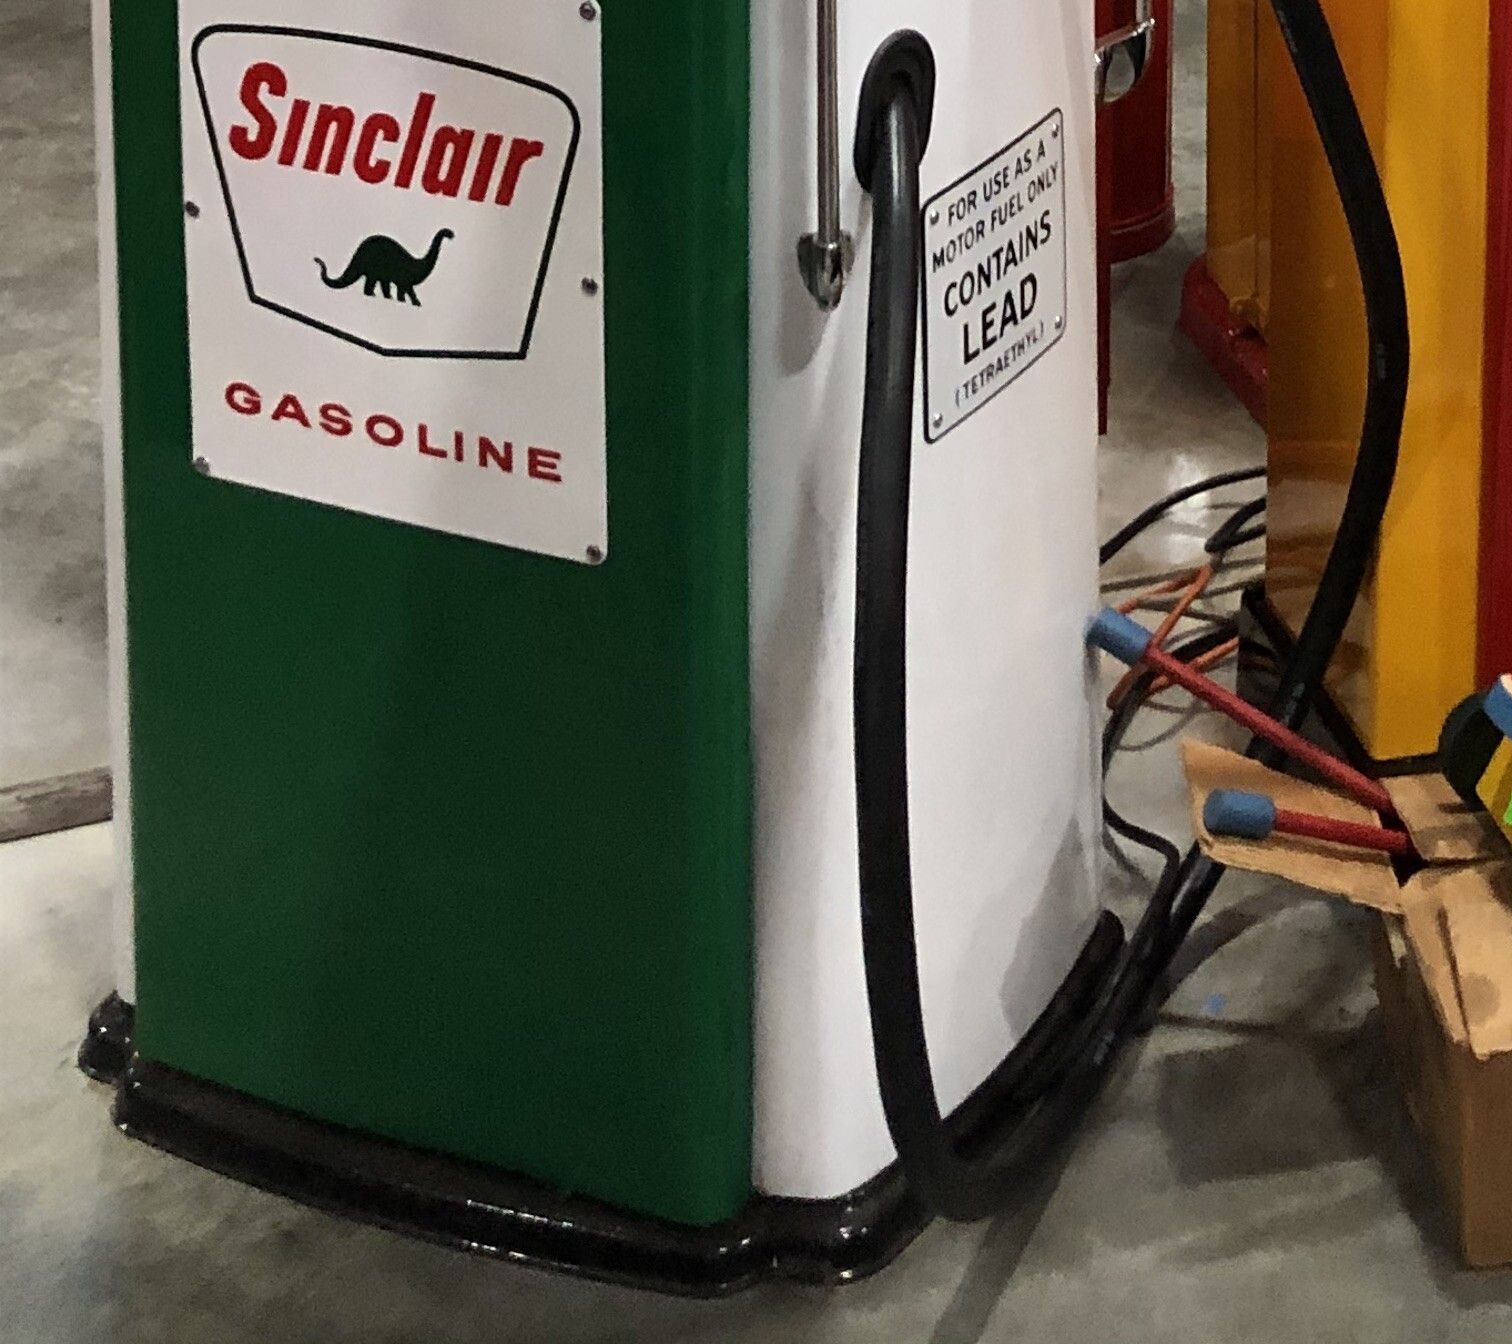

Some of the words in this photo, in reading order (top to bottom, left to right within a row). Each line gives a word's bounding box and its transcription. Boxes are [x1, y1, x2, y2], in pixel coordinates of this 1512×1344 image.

[228, 58, 546, 208] Sinclair
[947, 188, 978, 228] FOR
[982, 167, 1011, 204] USE
[1014, 152, 1033, 181] AS
[1036, 139, 1047, 163] A
[932, 218, 987, 274] MOTOR
[990, 195, 1024, 232] FUEL
[1027, 161, 1060, 205] ONLY
[943, 208, 1052, 318] CONTAINS
[962, 272, 1038, 366] LEAD
[224, 378, 565, 485] GASOLINE
